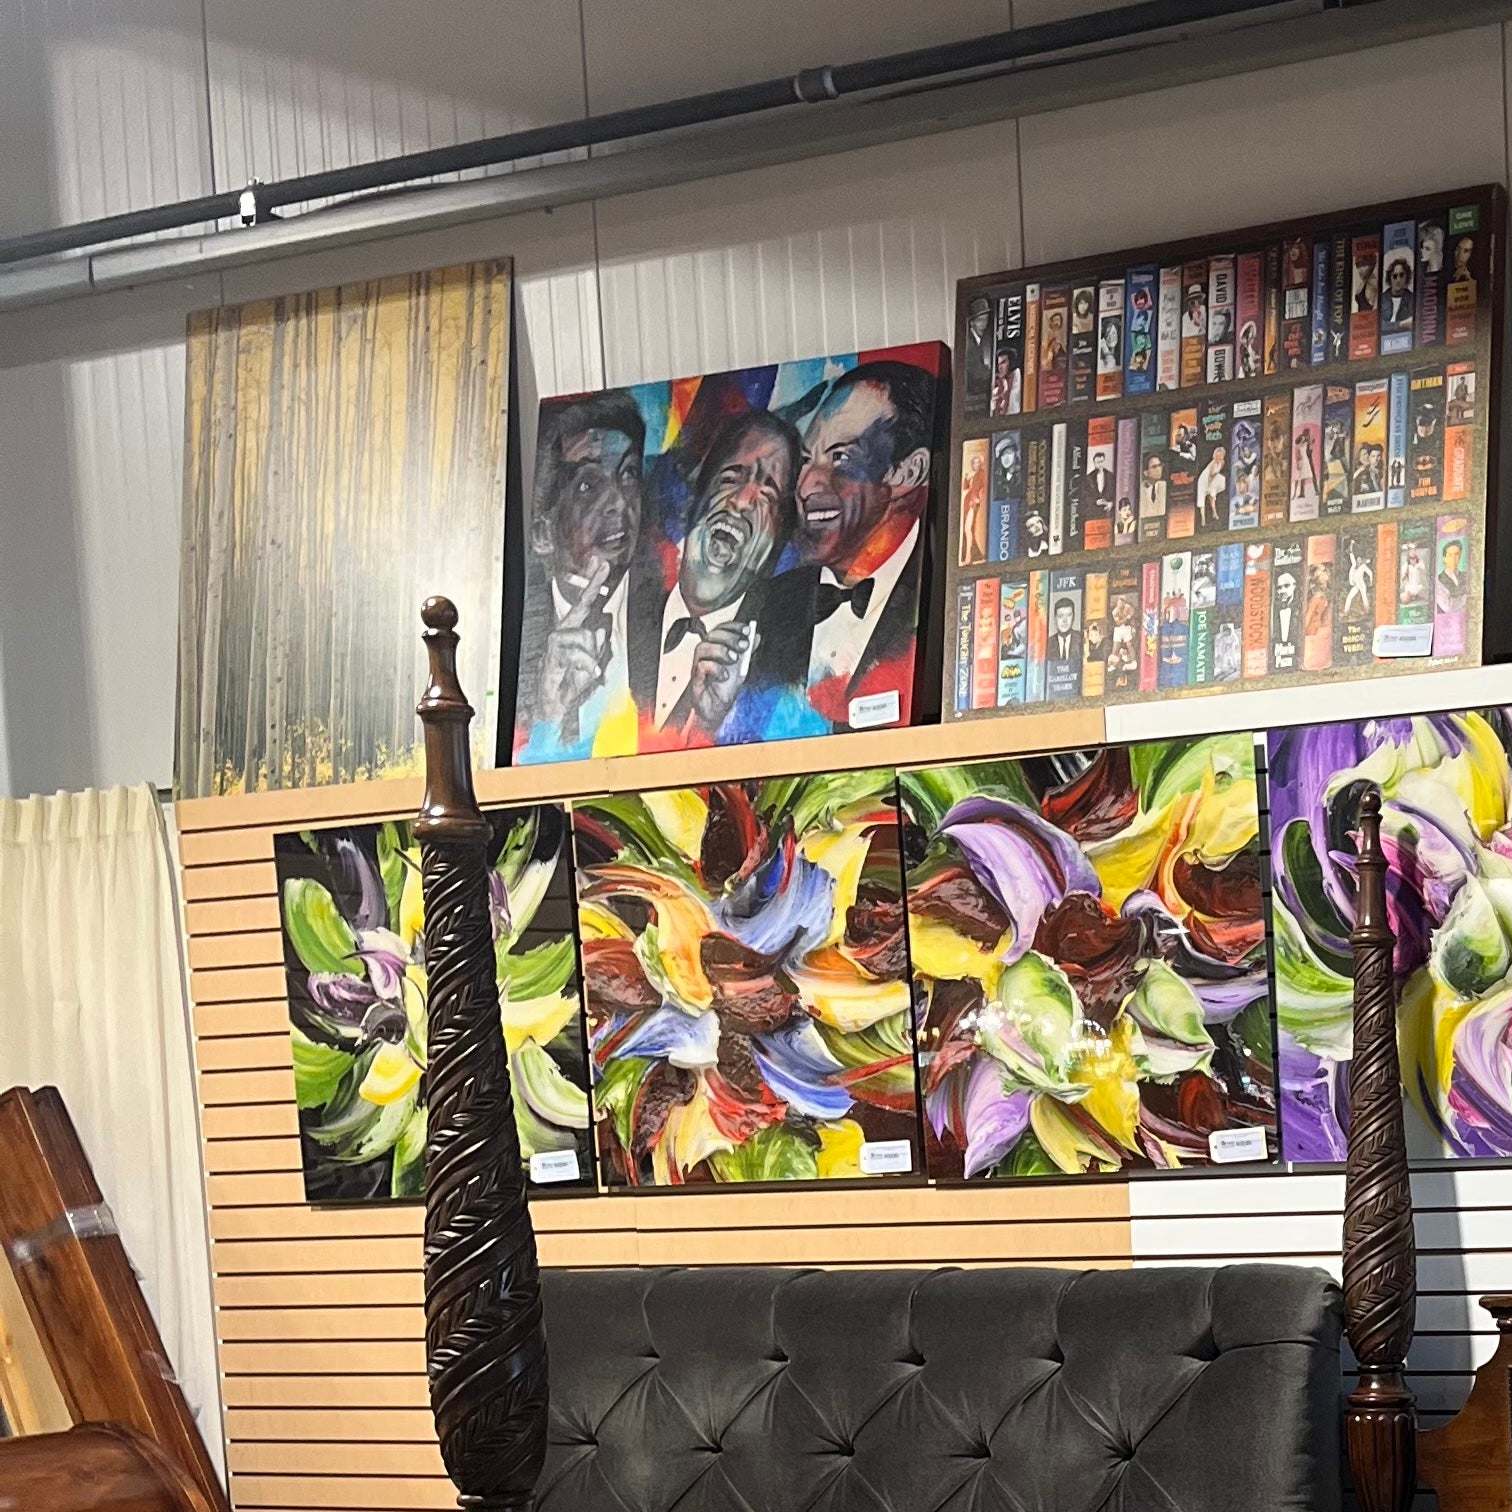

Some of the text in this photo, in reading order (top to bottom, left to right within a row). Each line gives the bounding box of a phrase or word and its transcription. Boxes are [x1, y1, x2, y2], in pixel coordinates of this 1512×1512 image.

[1215, 273, 1228, 304] DAVID
[1422, 276, 1438, 344] MADONNA
[1007, 295, 1022, 339] ELVIS
[1333, 304, 1344, 325] POP
[1213, 349, 1226, 383] BOWIE
[1453, 430, 1465, 492] THE GRADUATE
[999, 504, 1011, 561] BRANDO
[1057, 576, 1077, 589] JFK
[1249, 577, 1266, 649] WOODSTOCK
[1056, 664, 1070, 673] THE
[1196, 610, 1207, 683] JOE NAMATH
